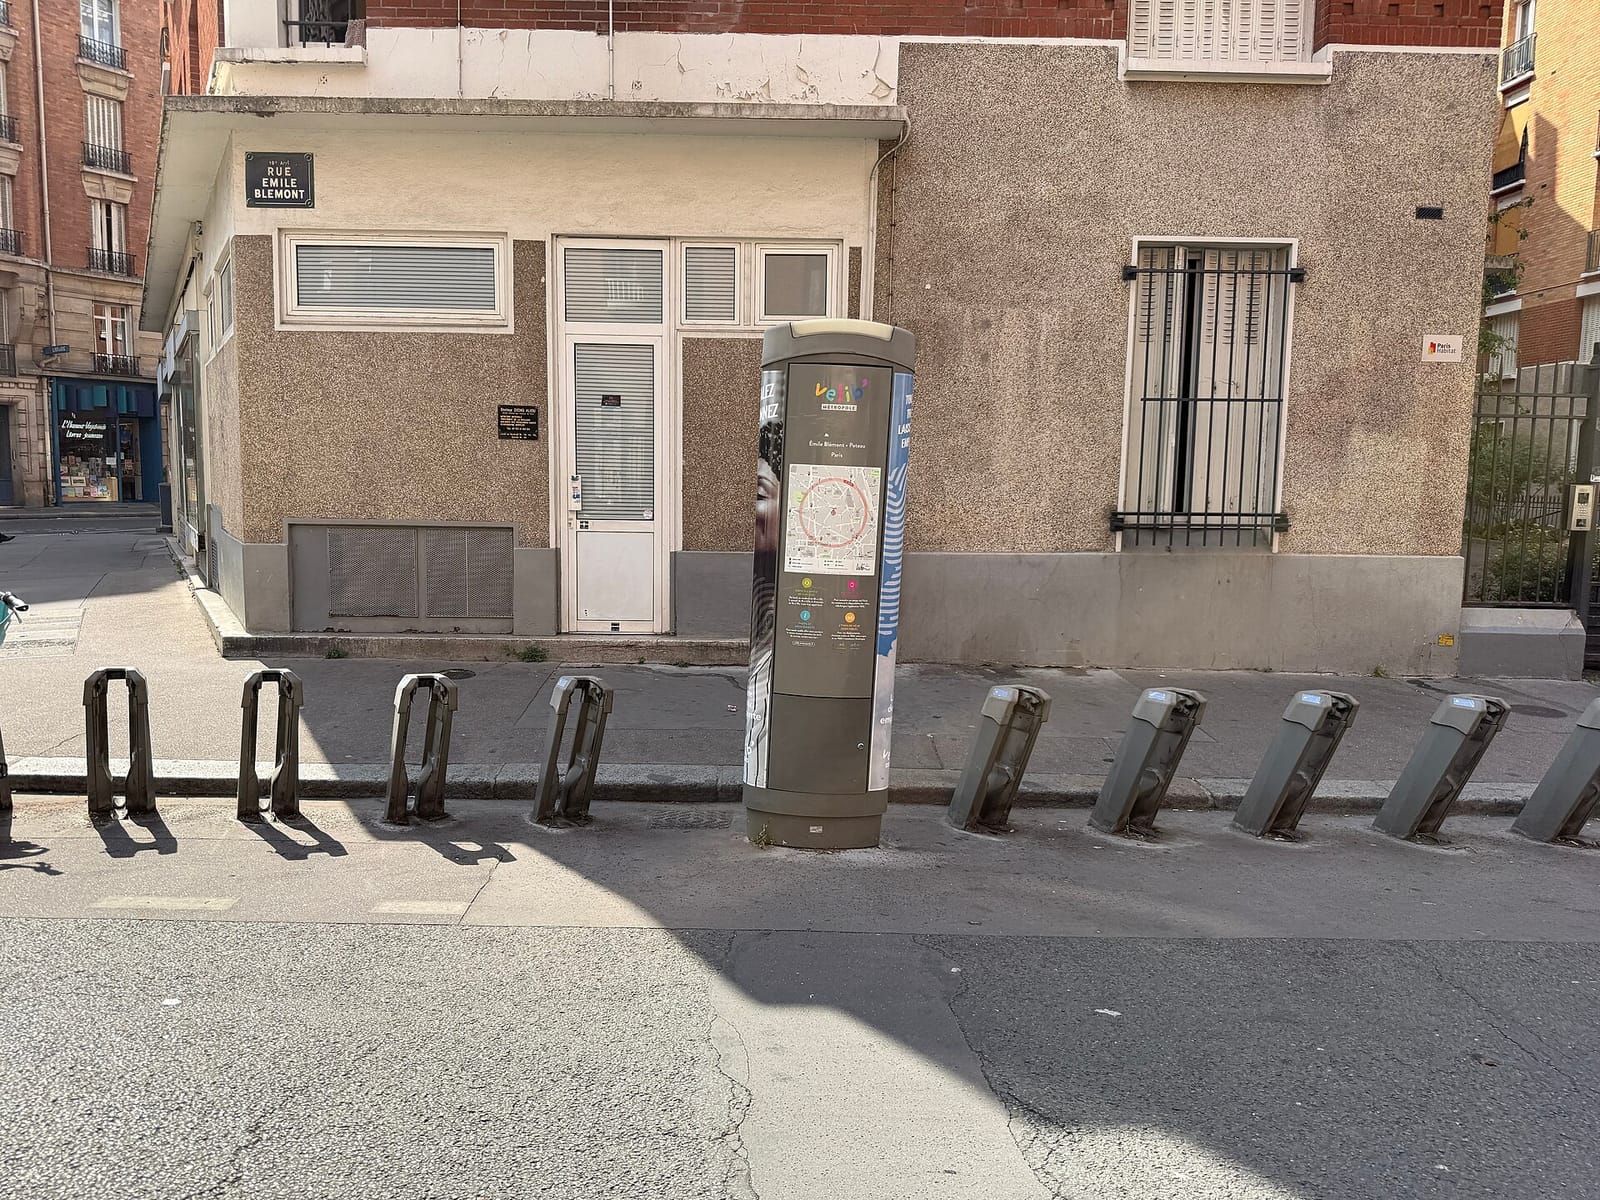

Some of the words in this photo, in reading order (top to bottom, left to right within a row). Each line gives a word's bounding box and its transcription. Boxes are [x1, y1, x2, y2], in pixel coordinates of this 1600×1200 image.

[267, 166, 292, 177] RUE
[262, 177, 298, 188] EMILE
[254, 188, 305, 200] BLEMONT
